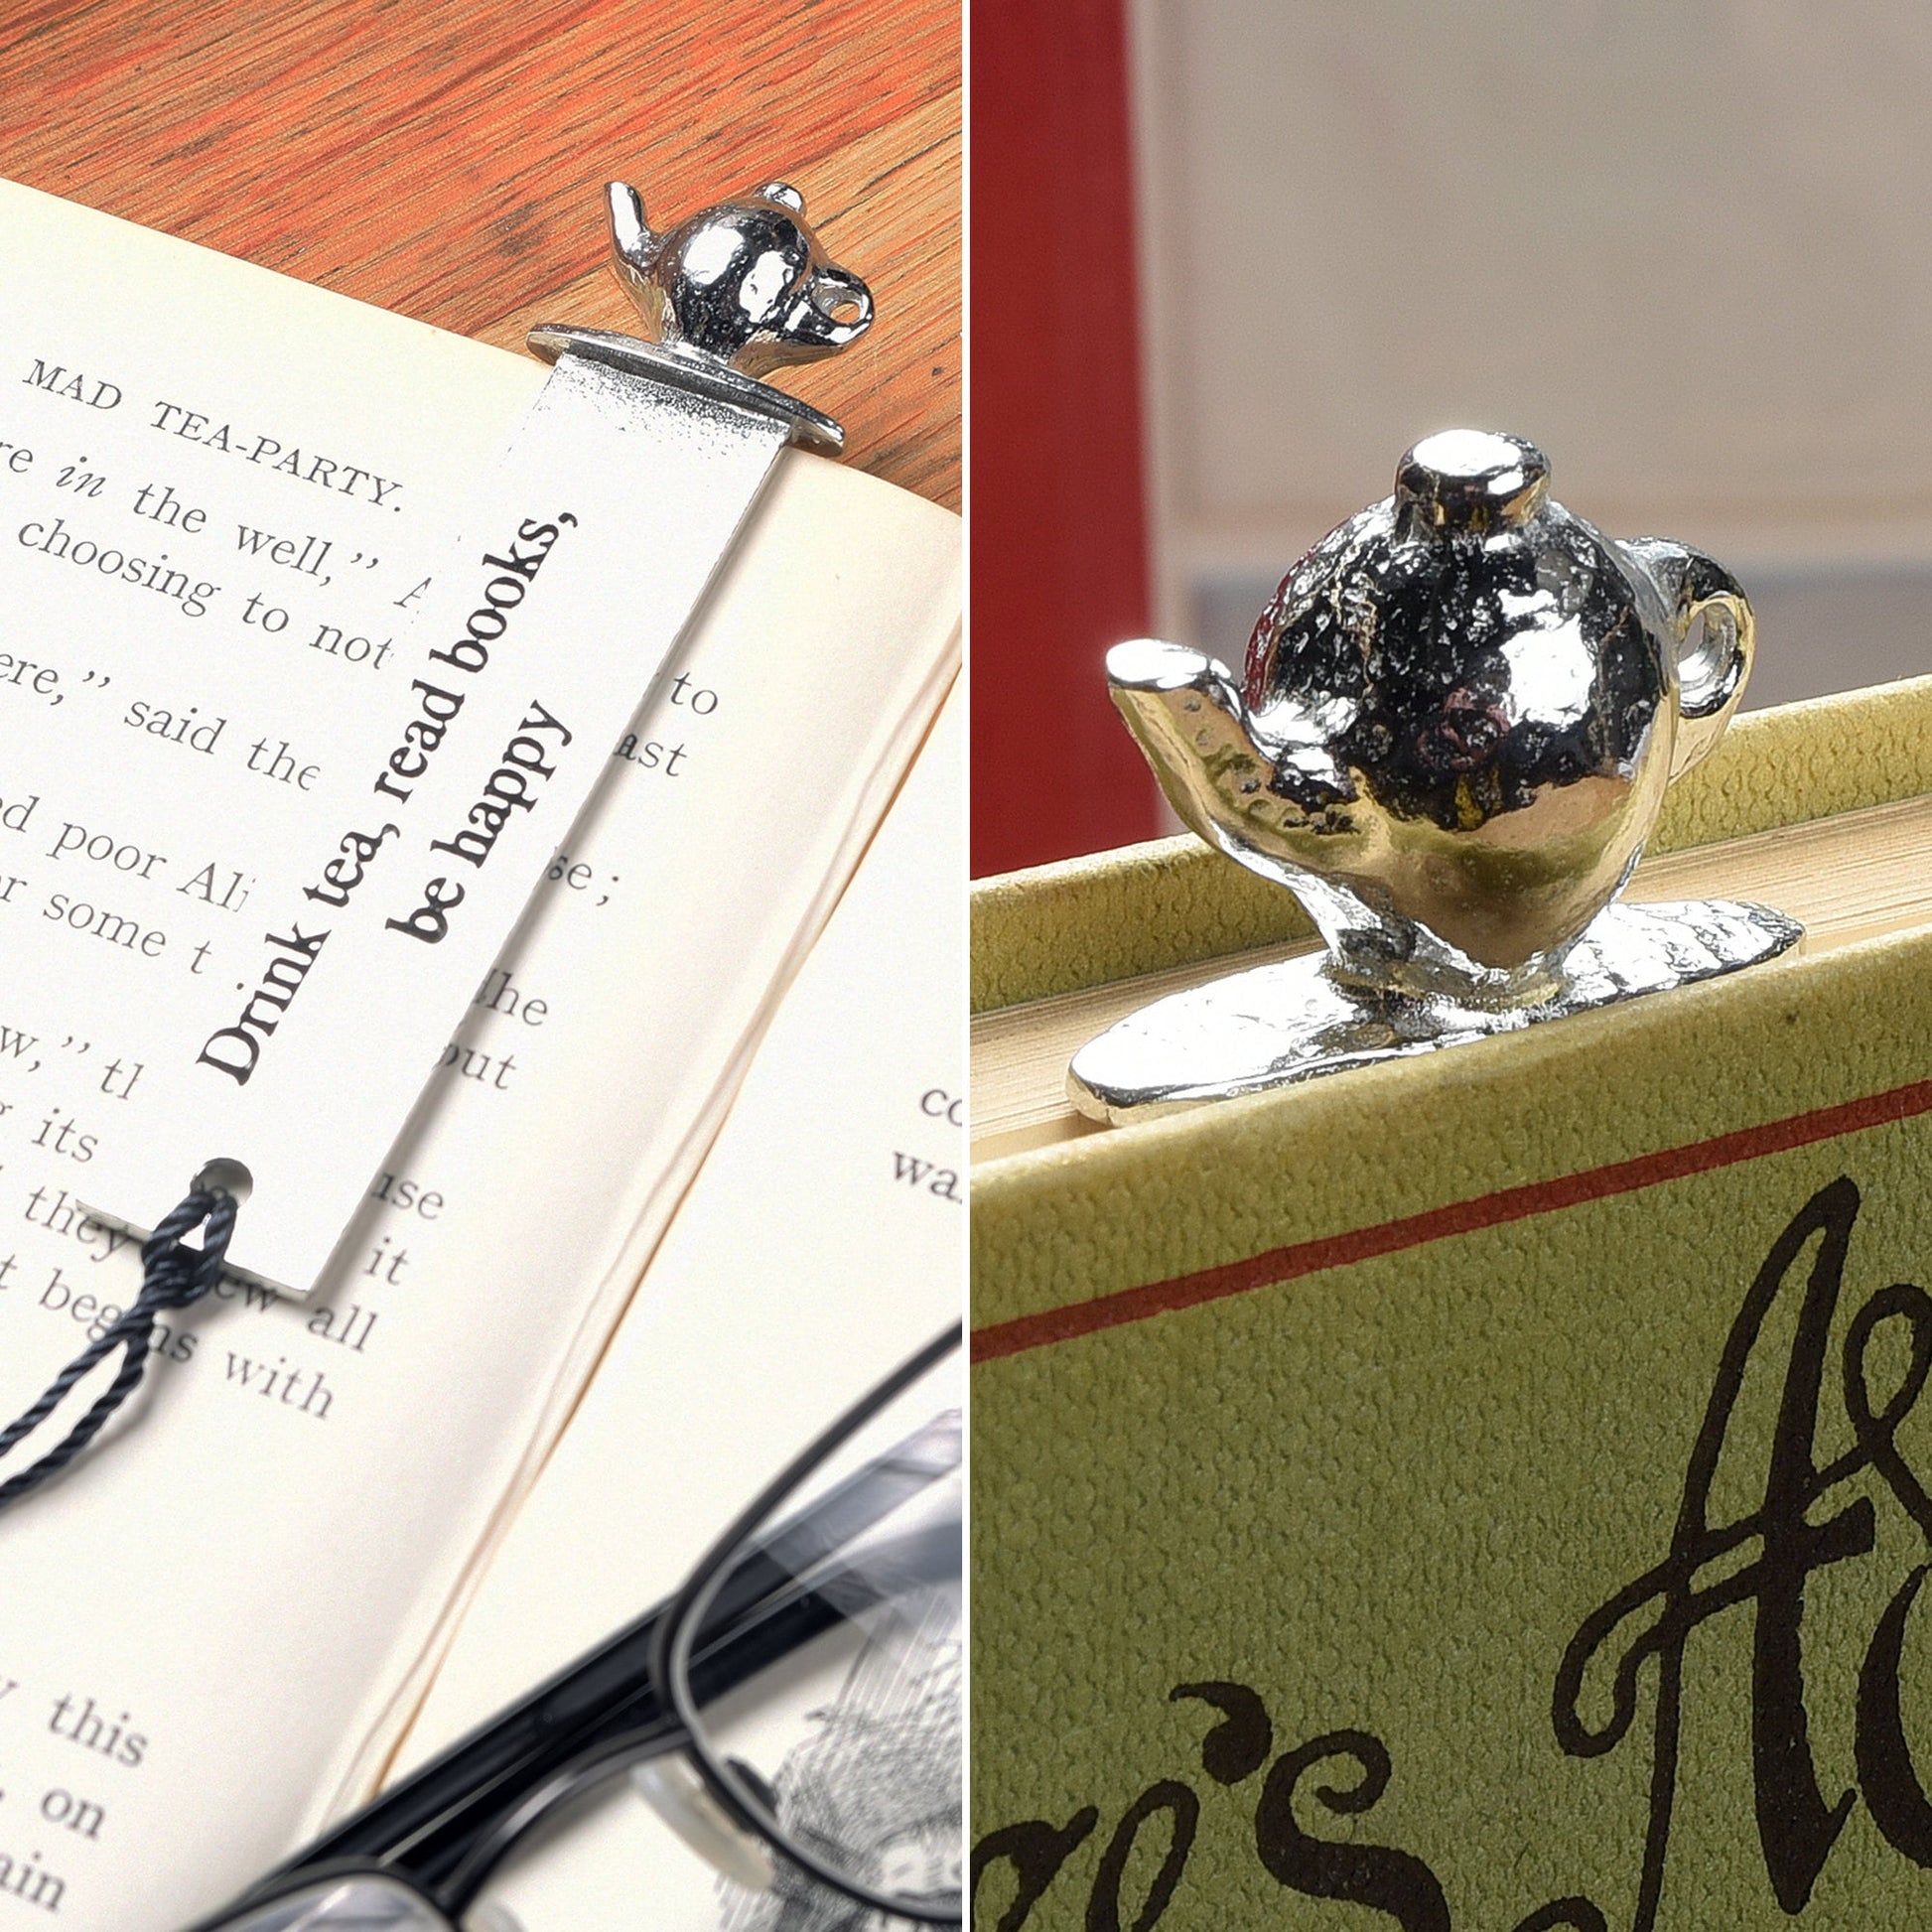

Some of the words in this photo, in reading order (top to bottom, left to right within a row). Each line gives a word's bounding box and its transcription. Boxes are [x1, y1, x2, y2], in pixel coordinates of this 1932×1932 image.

[22, 358, 122, 410] MAD
[151, 401, 403, 512] TEA-PARTY.
[18, 518, 221, 618] choosing
[241, 593, 289, 632] to
[56, 456, 106, 497] in
[133, 483, 207, 533] the
[670, 672, 719, 715] to
[124, 701, 226, 755] said
[247, 738, 322, 791] the
[196, 922, 333, 1087] Drink
[303, 823, 400, 907] tea,
[374, 679, 465, 804] read
[429, 512, 578, 673] books,
[46, 822, 167, 880] poor
[385, 878, 466, 944] be
[430, 700, 572, 869] happy
[43, 894, 166, 957] some
[25, 1185, 134, 1262] they
[308, 1306, 377, 1353] all
[32, 1108, 98, 1163] its
[364, 1236, 409, 1286] it
[39, 1268, 198, 1362] begns
[226, 1352, 334, 1419] with
[49, 1692, 148, 1768] this
[40, 1788, 106, 1840] on
